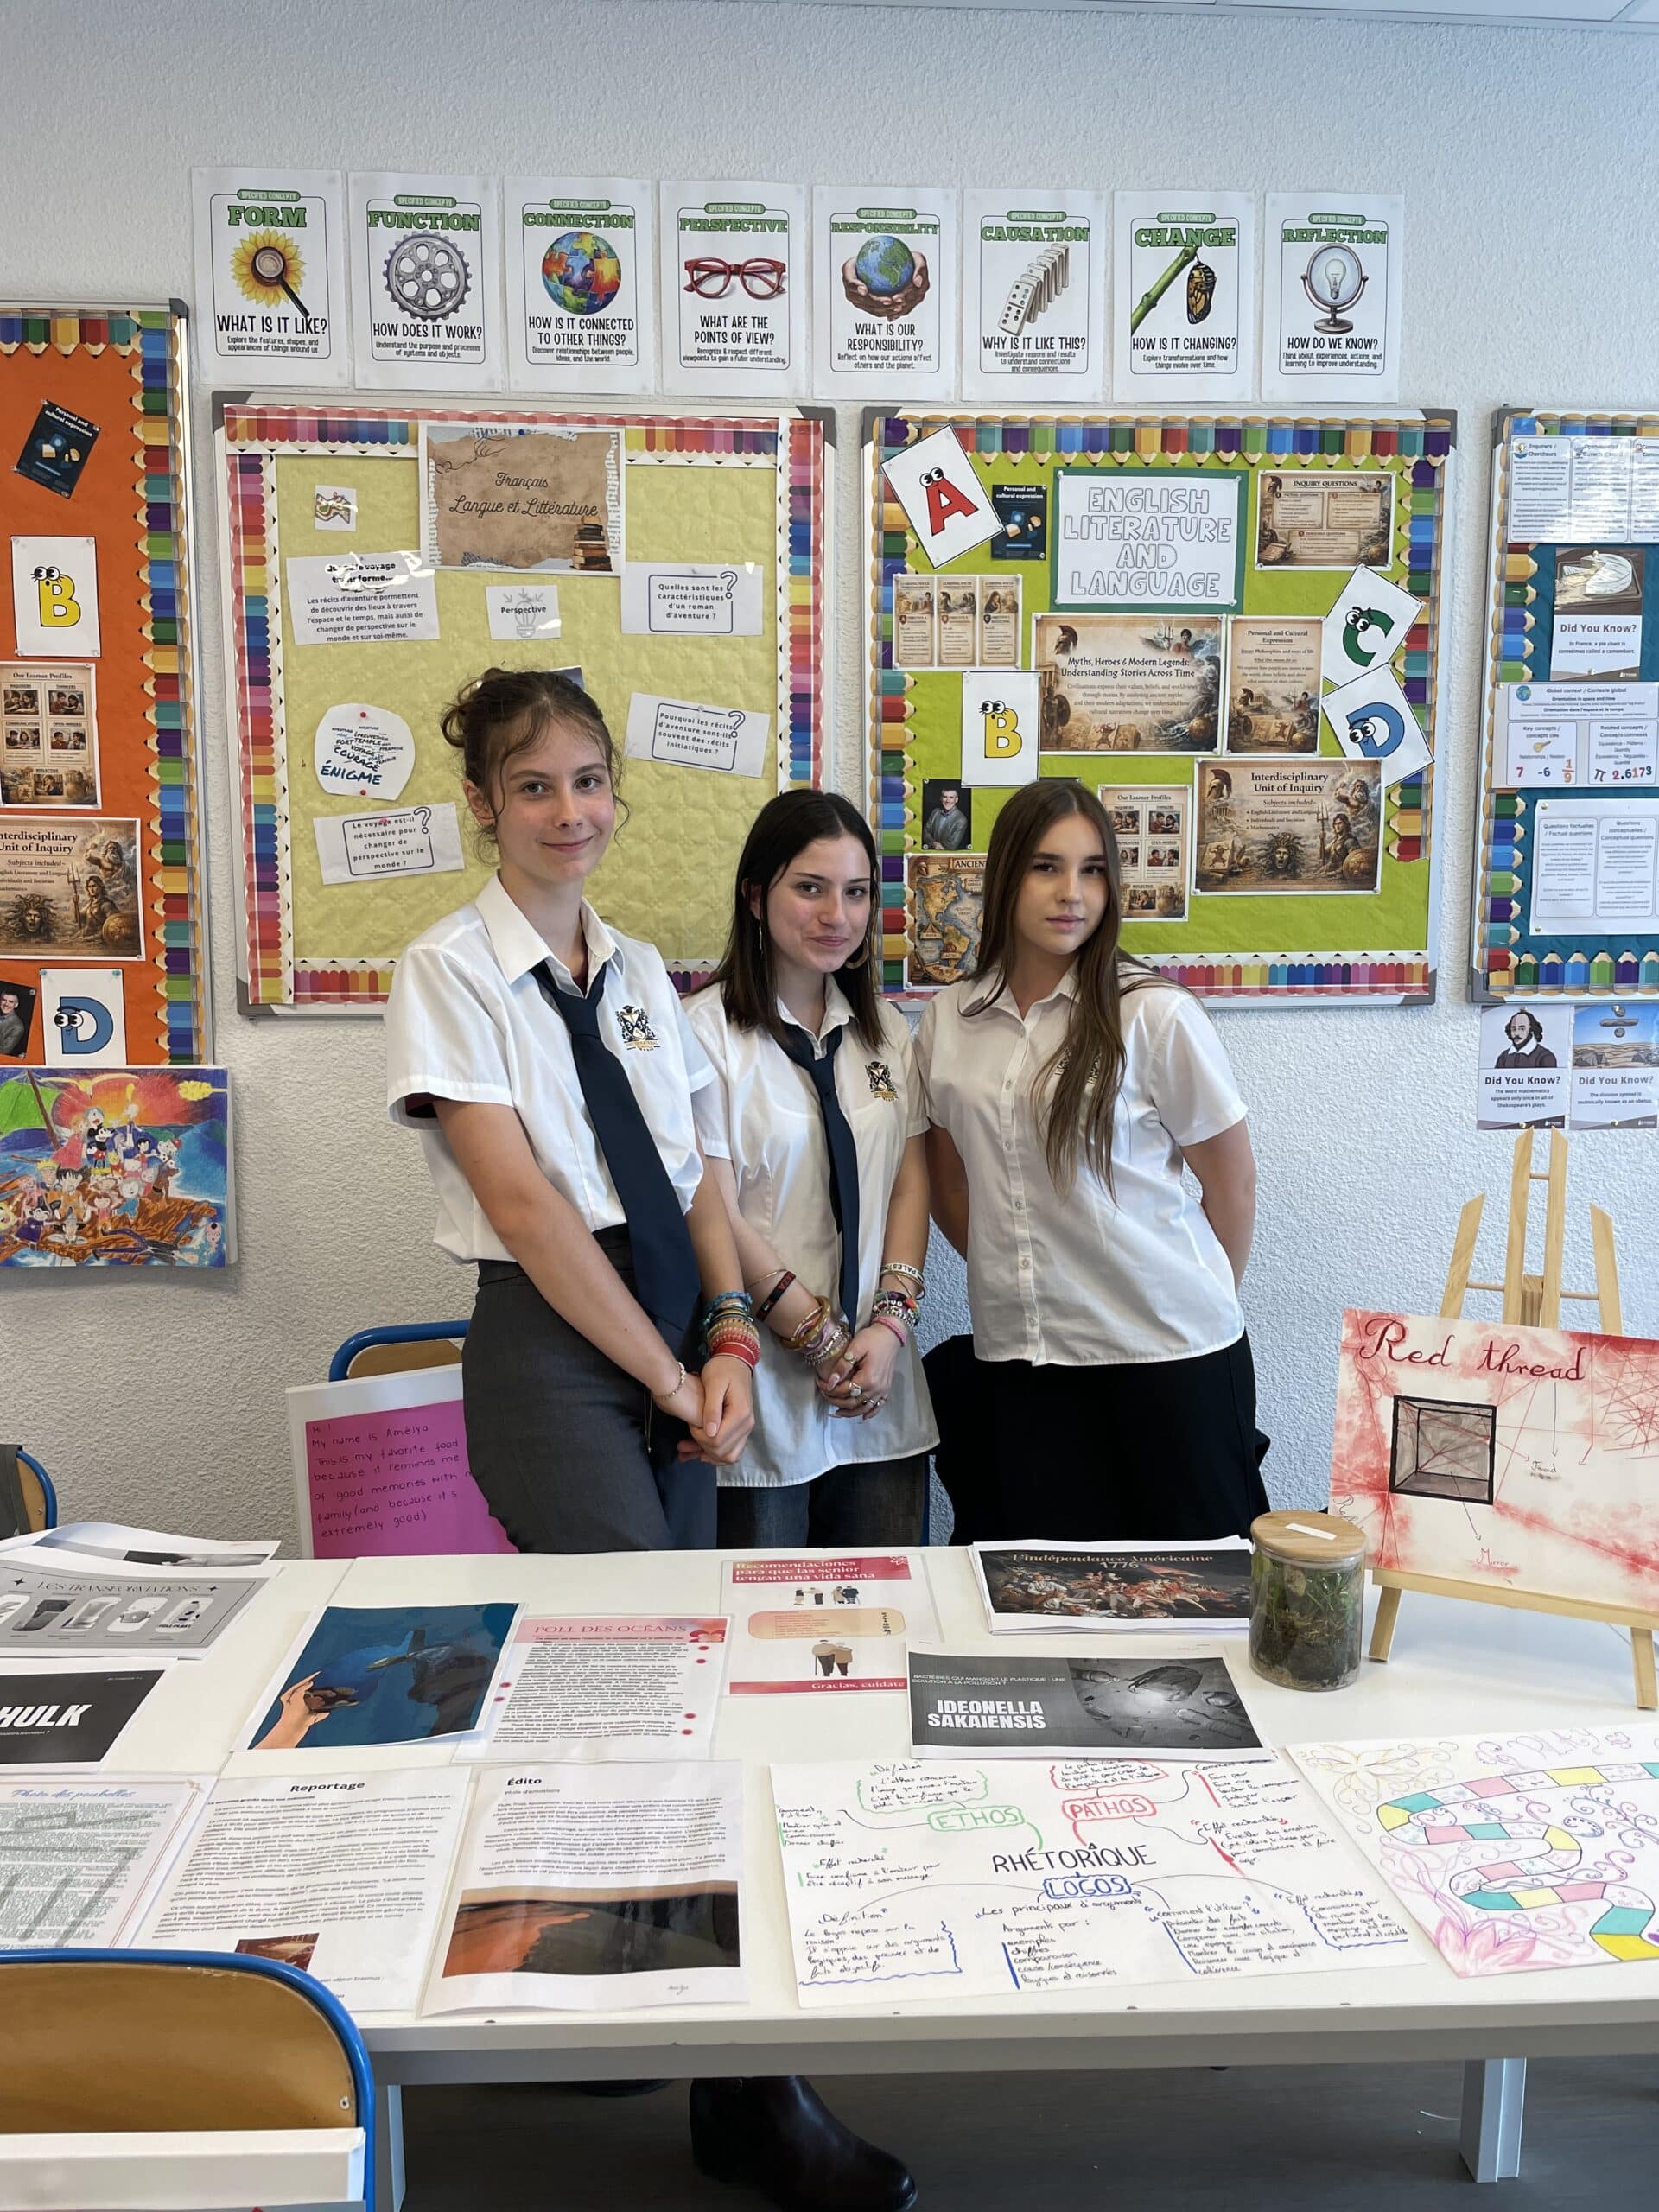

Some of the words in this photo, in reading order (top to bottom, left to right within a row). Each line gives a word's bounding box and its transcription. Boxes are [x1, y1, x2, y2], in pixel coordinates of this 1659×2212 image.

[228, 206, 307, 227] FORM
[368, 211, 480, 231] FUNCTION
[524, 213, 634, 229] CONNECTION
[679, 218, 787, 232] PERSPECTIVE
[831, 222, 940, 234] RESPONSIBILITY
[982, 226, 1089, 242] CAUSATION
[1135, 227, 1236, 247] CHANGE
[1282, 229, 1387, 244] REFLECTION
[217, 315, 256, 332] WHAT
[261, 316, 271, 333] IS
[277, 317, 288, 333] IT
[295, 318, 327, 334] LIKE?
[529, 317, 552, 329] HOW
[555, 318, 563, 329] IS
[566, 318, 575, 330] IT
[579, 318, 634, 331] CONNECTED
[700, 315, 728, 328] WHAT
[731, 316, 748, 328] ARE
[752, 316, 768, 329] THE
[855, 323, 883, 336] WHAT
[887, 324, 895, 336] IS
[897, 324, 915, 337] OUR
[373, 323, 397, 336] HOW
[402, 324, 428, 337] DOES
[431, 325, 442, 338] IT
[446, 326, 482, 340] WORK?
[537, 333, 550, 345] TO
[554, 334, 584, 346] OTHER
[588, 334, 626, 346] THINGS?
[695, 331, 728, 343] POINTS
[731, 332, 742, 344] OF
[746, 332, 774, 345] VIEW?
[847, 339, 924, 352] RESPONSIBILITY?
[982, 337, 1007, 350] WHY
[1010, 338, 1019, 349] IS
[1022, 338, 1032, 349] IT
[1035, 338, 1055, 350] LIKE
[1058, 338, 1086, 350] THIS?
[1133, 338, 1156, 350] HOW
[1159, 338, 1168, 350] IS
[1171, 338, 1179, 350] IT
[1184, 338, 1236, 351] CHANGING?
[1287, 337, 1310, 349] HOW
[1313, 338, 1325, 349] DO
[1328, 338, 1342, 349] WE
[1345, 338, 1378, 351] KNOW?
[495, 473, 548, 489] Français
[449, 495, 504, 518] Langue
[508, 499, 518, 512] et
[521, 498, 599, 517] Littérature
[926, 477, 979, 537] A
[1088, 487, 1210, 514] ENGLISH
[1064, 515, 1231, 543] LITERATURE
[1116, 543, 1177, 569] AND
[1071, 571, 1221, 597] LANGUAGE
[38, 575, 81, 627] B
[379, 593, 419, 601] permettent
[1560, 624, 1577, 632] Did
[1343, 607, 1395, 667] C
[1068, 658, 1093, 669] Myths,
[1159, 658, 1189, 667] Legends:
[1061, 669, 1117, 678] Understanding
[660, 713, 694, 723] Pourquoi
[711, 721, 733, 730] récits
[984, 706, 1022, 758] B
[1346, 702, 1405, 758] D
[658, 731, 689, 741] souvent
[708, 739, 729, 747] récits
[351, 746, 375, 756] VOYAGE
[334, 747, 380, 772] COURAGE
[321, 760, 382, 785] ÉNIGME
[1251, 772, 1328, 783] Interdisciplinary
[1516, 767, 1523, 777] 7
[1277, 783, 1287, 791] of
[1290, 784, 1324, 793] Inquiry
[59, 996, 113, 1055] D
[1359, 1318, 1454, 1367] Red
[1477, 1341, 1586, 1380] thread
[312, 1440, 326, 1448] My
[332, 1435, 360, 1444] name
[321, 1520, 384, 1538] extremely
[393, 1511, 427, 1527] good)
[937, 1700, 1044, 1714] IDEONELLA
[0, 1704, 92, 1727] HULK
[928, 1713, 1046, 1729] SAKAIENSIS
[291, 1782, 365, 1793] Reportage
[507, 1777, 542, 1786] Édito
[1071, 1798, 1147, 1819] PATHOS
[936, 1808, 1018, 1828] ETHOS
[1048, 1877, 1124, 1897] LOGOS
